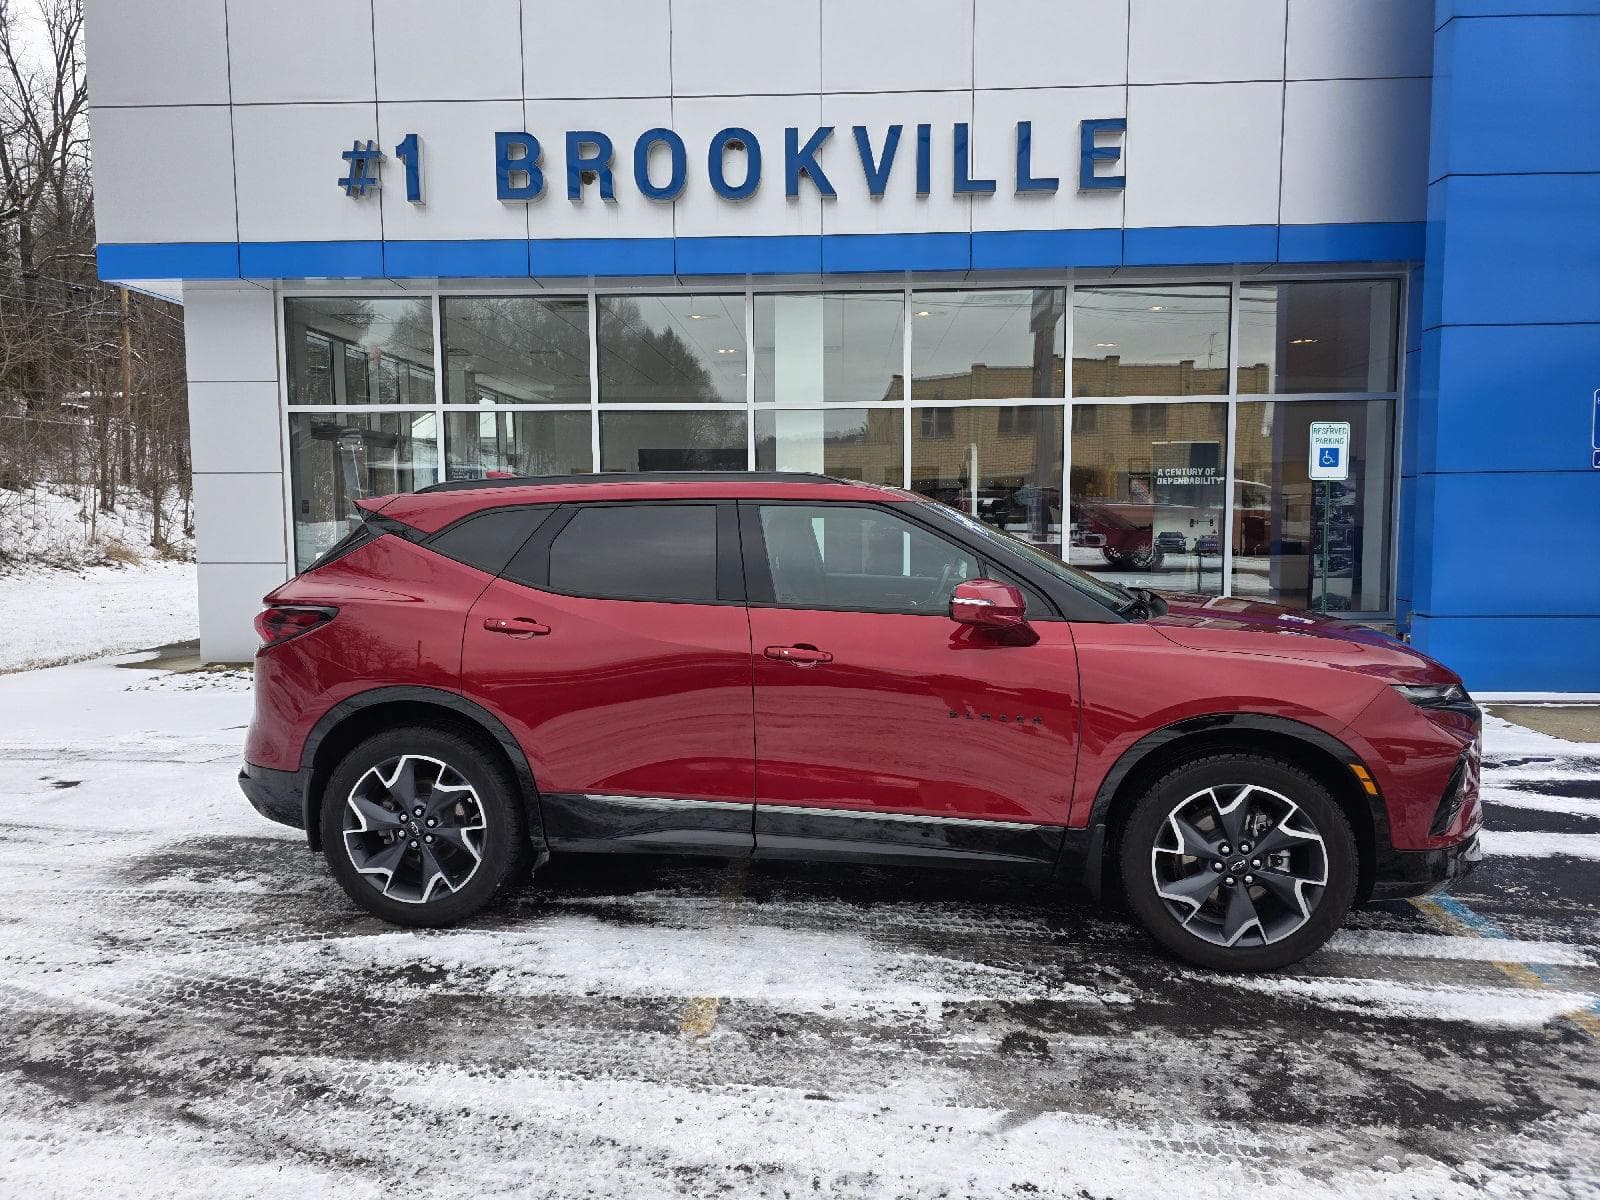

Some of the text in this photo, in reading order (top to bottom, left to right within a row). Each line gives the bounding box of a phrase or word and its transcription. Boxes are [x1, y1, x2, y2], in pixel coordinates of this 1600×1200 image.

[338, 118, 1128, 205] #1 BROOKVILLE
[1313, 427, 1347, 435] RESERVED
[1315, 437, 1345, 445] PARKING
[1157, 467, 1216, 476] A CENTURY OF
[1156, 476, 1222, 485] DEPENDABILITY
